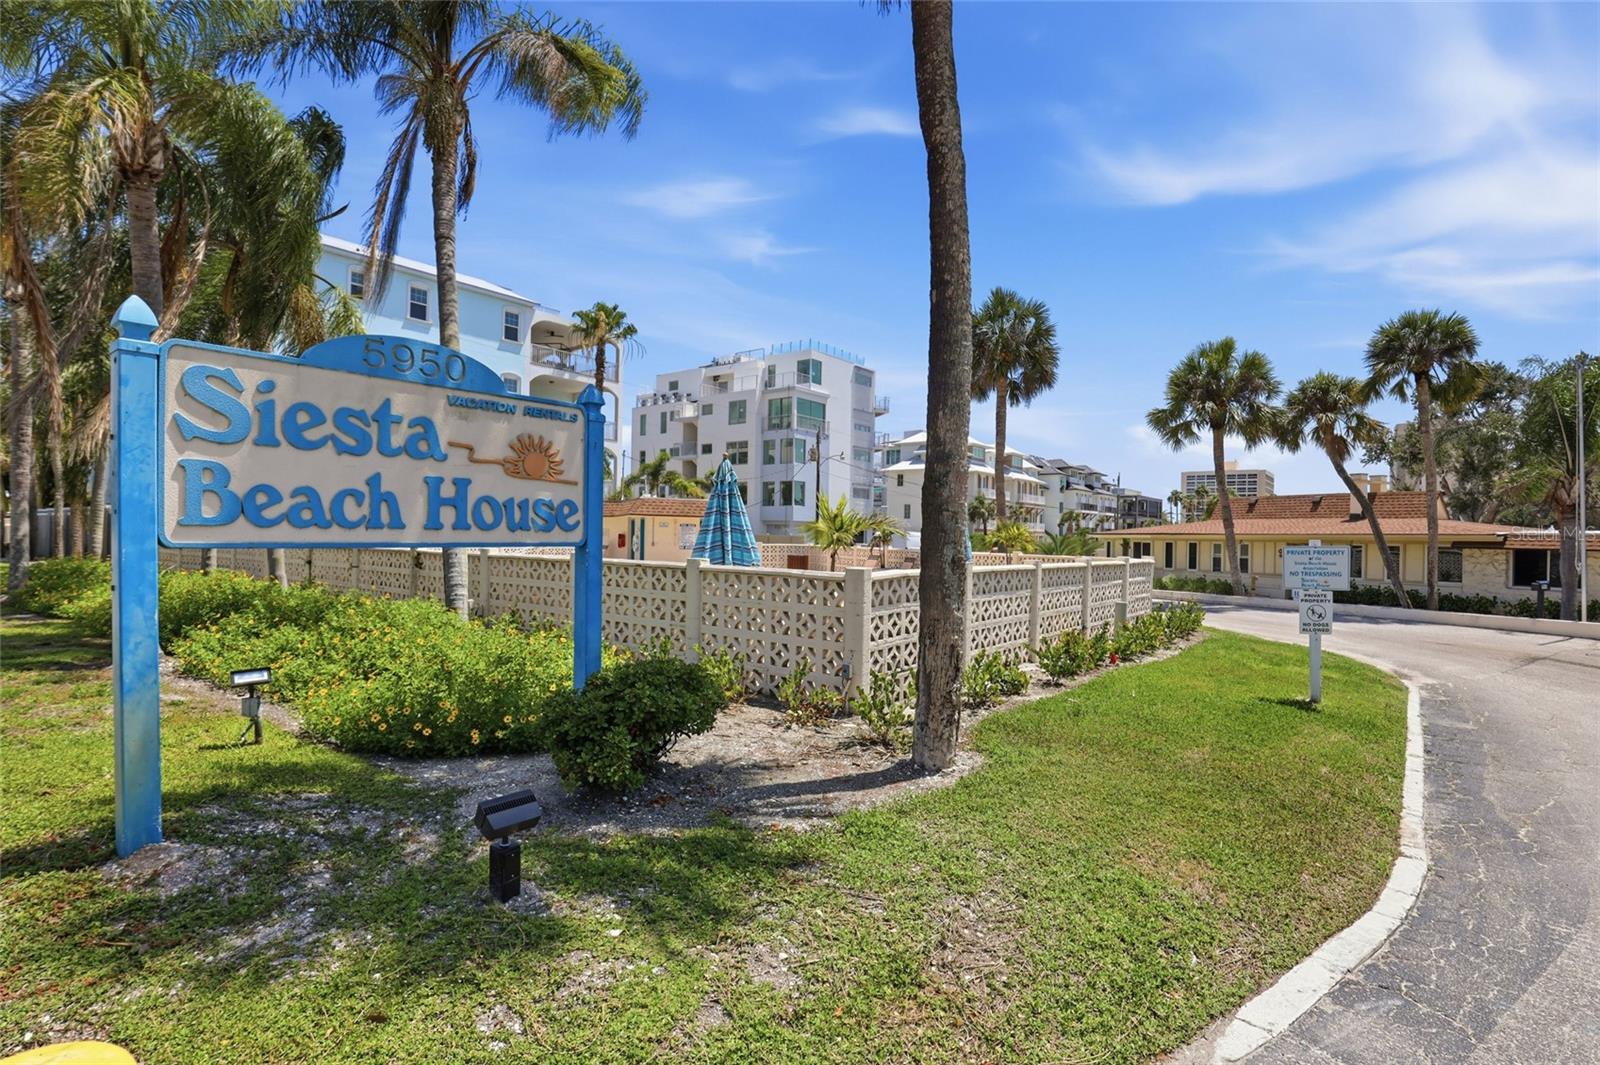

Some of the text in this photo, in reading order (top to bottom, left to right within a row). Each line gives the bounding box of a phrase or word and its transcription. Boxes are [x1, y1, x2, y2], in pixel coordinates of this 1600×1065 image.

[362, 337, 466, 384] 5950
[173, 364, 448, 462] Siesta
[447, 393, 578, 424] VACATION RENTALS
[176, 457, 582, 534] Beach House
